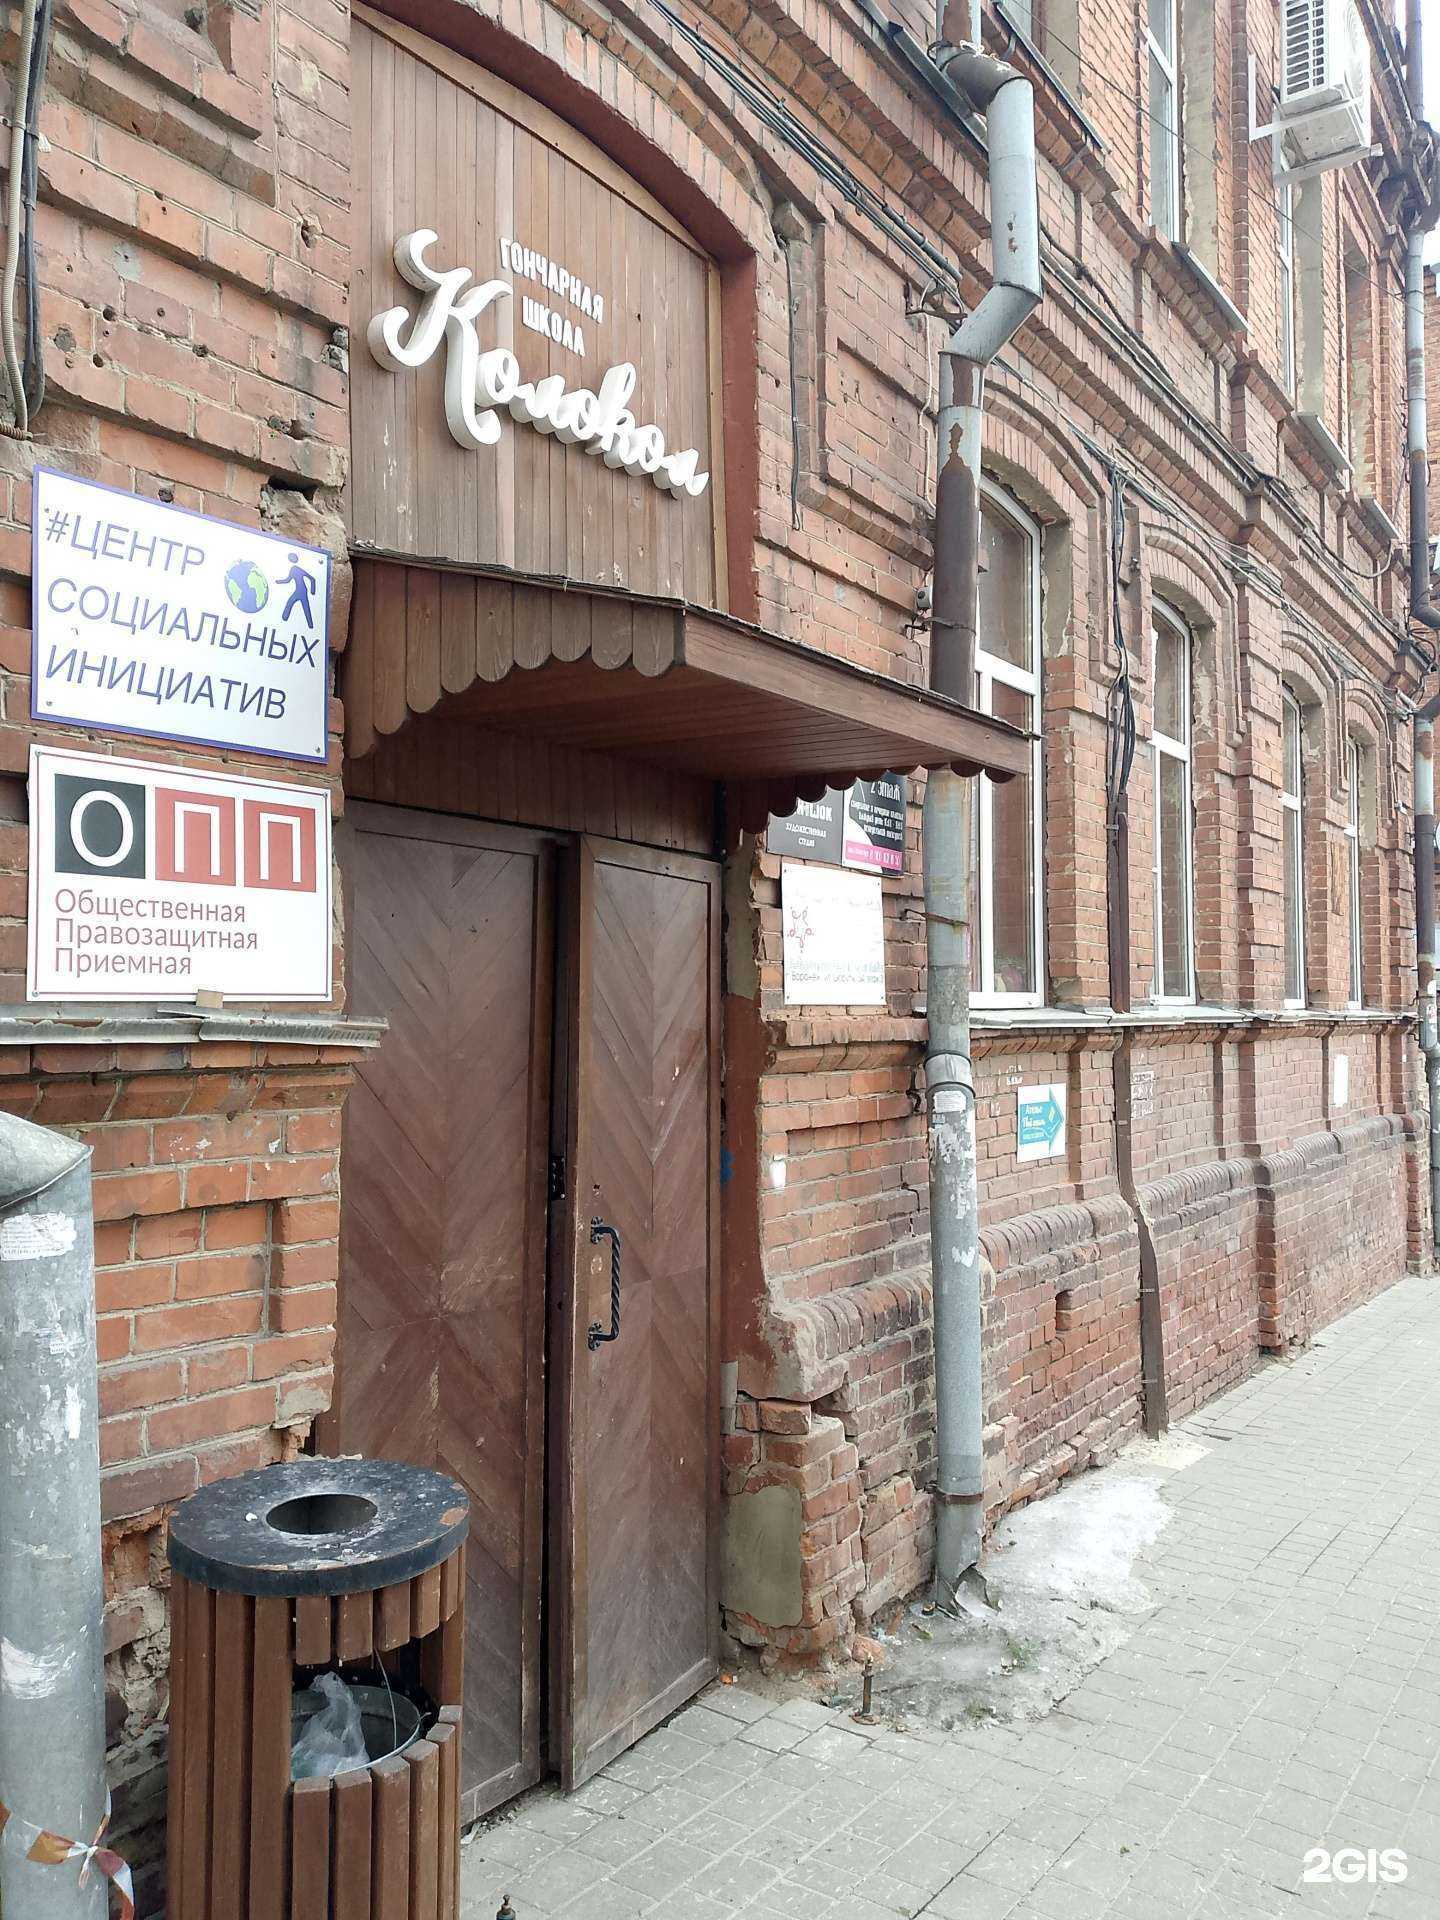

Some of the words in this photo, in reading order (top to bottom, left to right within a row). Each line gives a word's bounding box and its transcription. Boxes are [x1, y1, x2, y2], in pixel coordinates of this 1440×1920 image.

[500, 237, 604, 325] ГОНЧАРНАЯ
[522, 295, 586, 358] ШКОЛА
[45, 510, 205, 576] #ЦЕНТР
[47, 577, 320, 668] СОЦИАЛЬНЫХ
[45, 644, 287, 720] ИНИЦИАТИВ
[55, 888, 246, 923] Общественная
[55, 917, 259, 952] Правозащитная
[55, 947, 192, 978] Приемная
